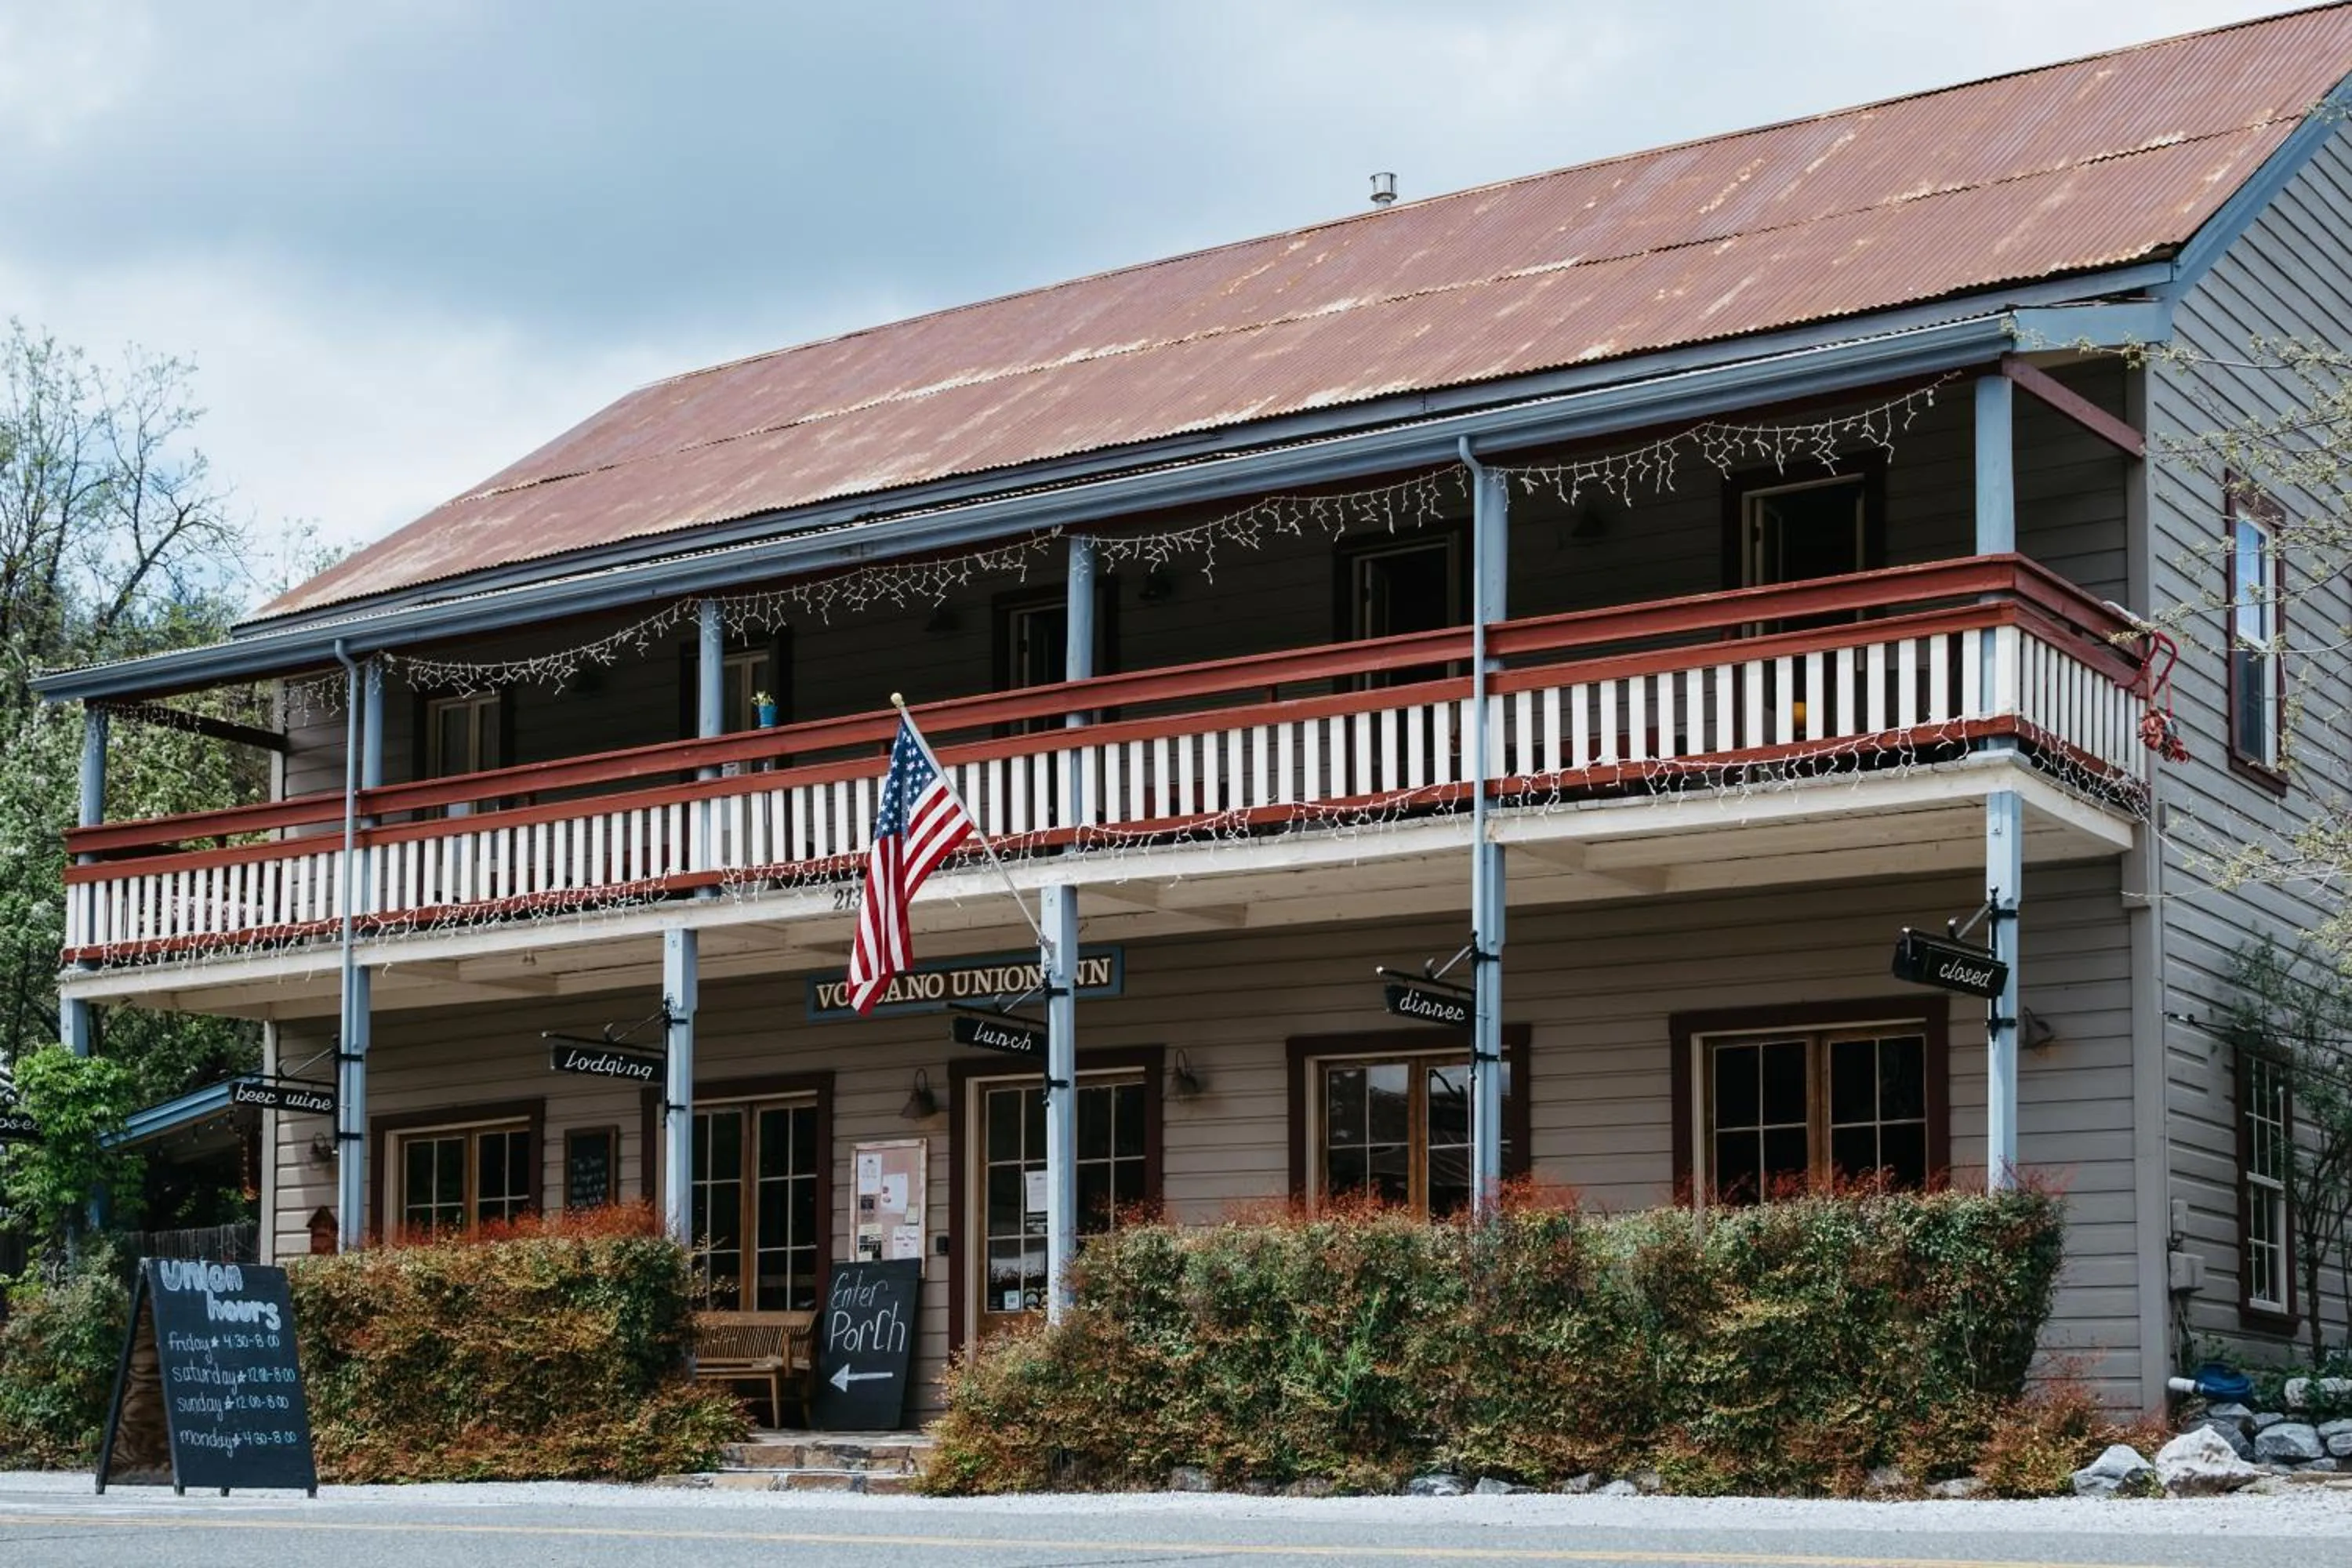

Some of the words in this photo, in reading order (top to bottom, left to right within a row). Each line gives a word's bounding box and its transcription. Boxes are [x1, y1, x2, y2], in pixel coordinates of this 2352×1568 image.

[814, 973, 945, 1009] VOANO
[950, 965, 1044, 996] UNION
[1939, 958, 1994, 988] closed
[1399, 989, 1465, 1020] dinner
[974, 1021, 1032, 1051] lunch
[236, 1083, 278, 1105] beer
[285, 1091, 332, 1110] wine
[831, 1269, 888, 1309] Enter
[206, 1289, 281, 1330] hours
